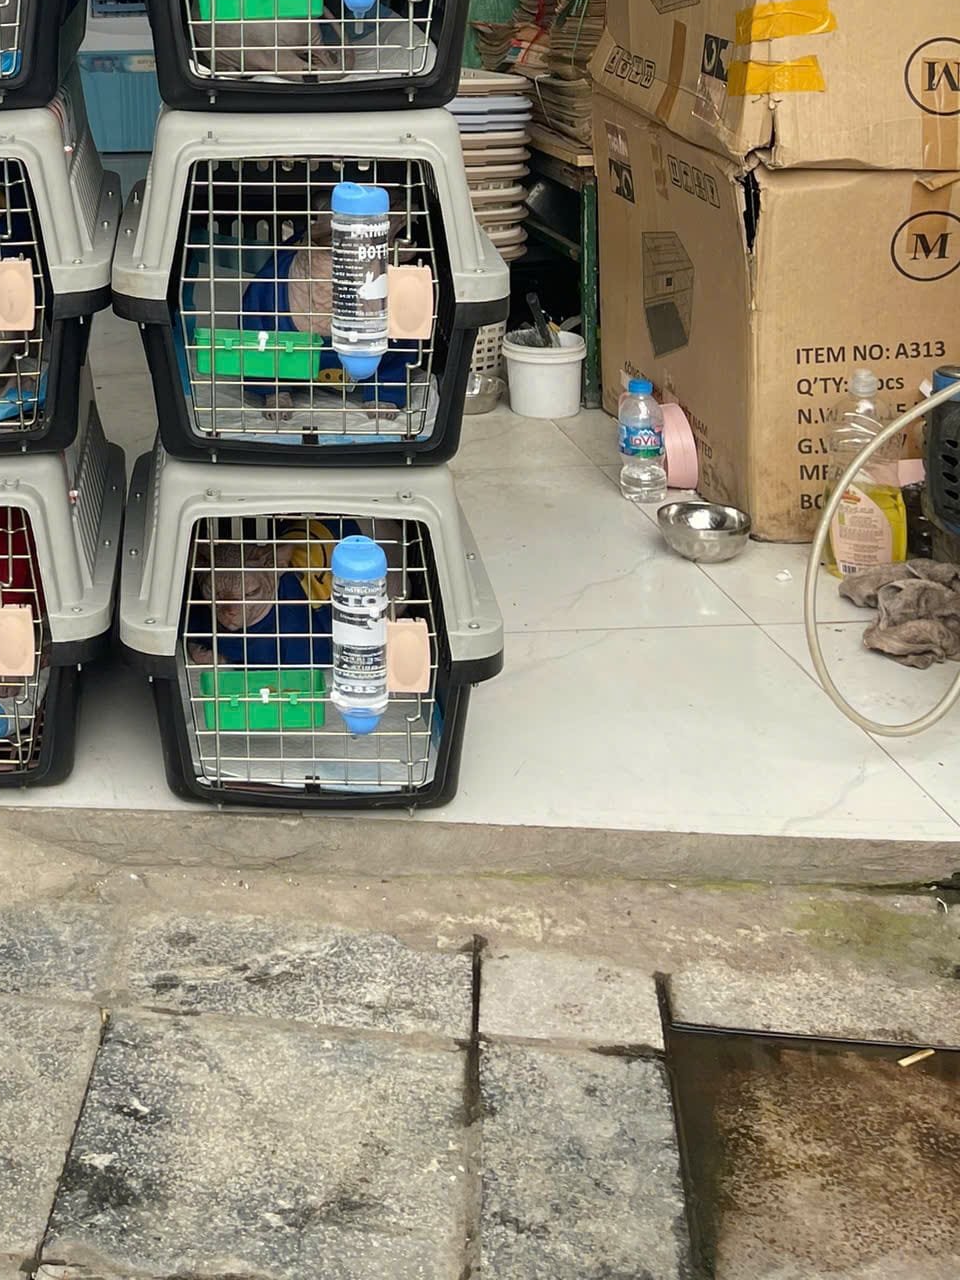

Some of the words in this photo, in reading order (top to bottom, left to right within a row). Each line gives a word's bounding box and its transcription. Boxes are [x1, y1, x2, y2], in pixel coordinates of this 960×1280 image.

[911, 232, 952, 261] M
[796, 346, 846, 365] ITEM
[853, 344, 890, 362] NO:
[895, 341, 946, 360] A313
[796, 377, 849, 397] Q'TY:
